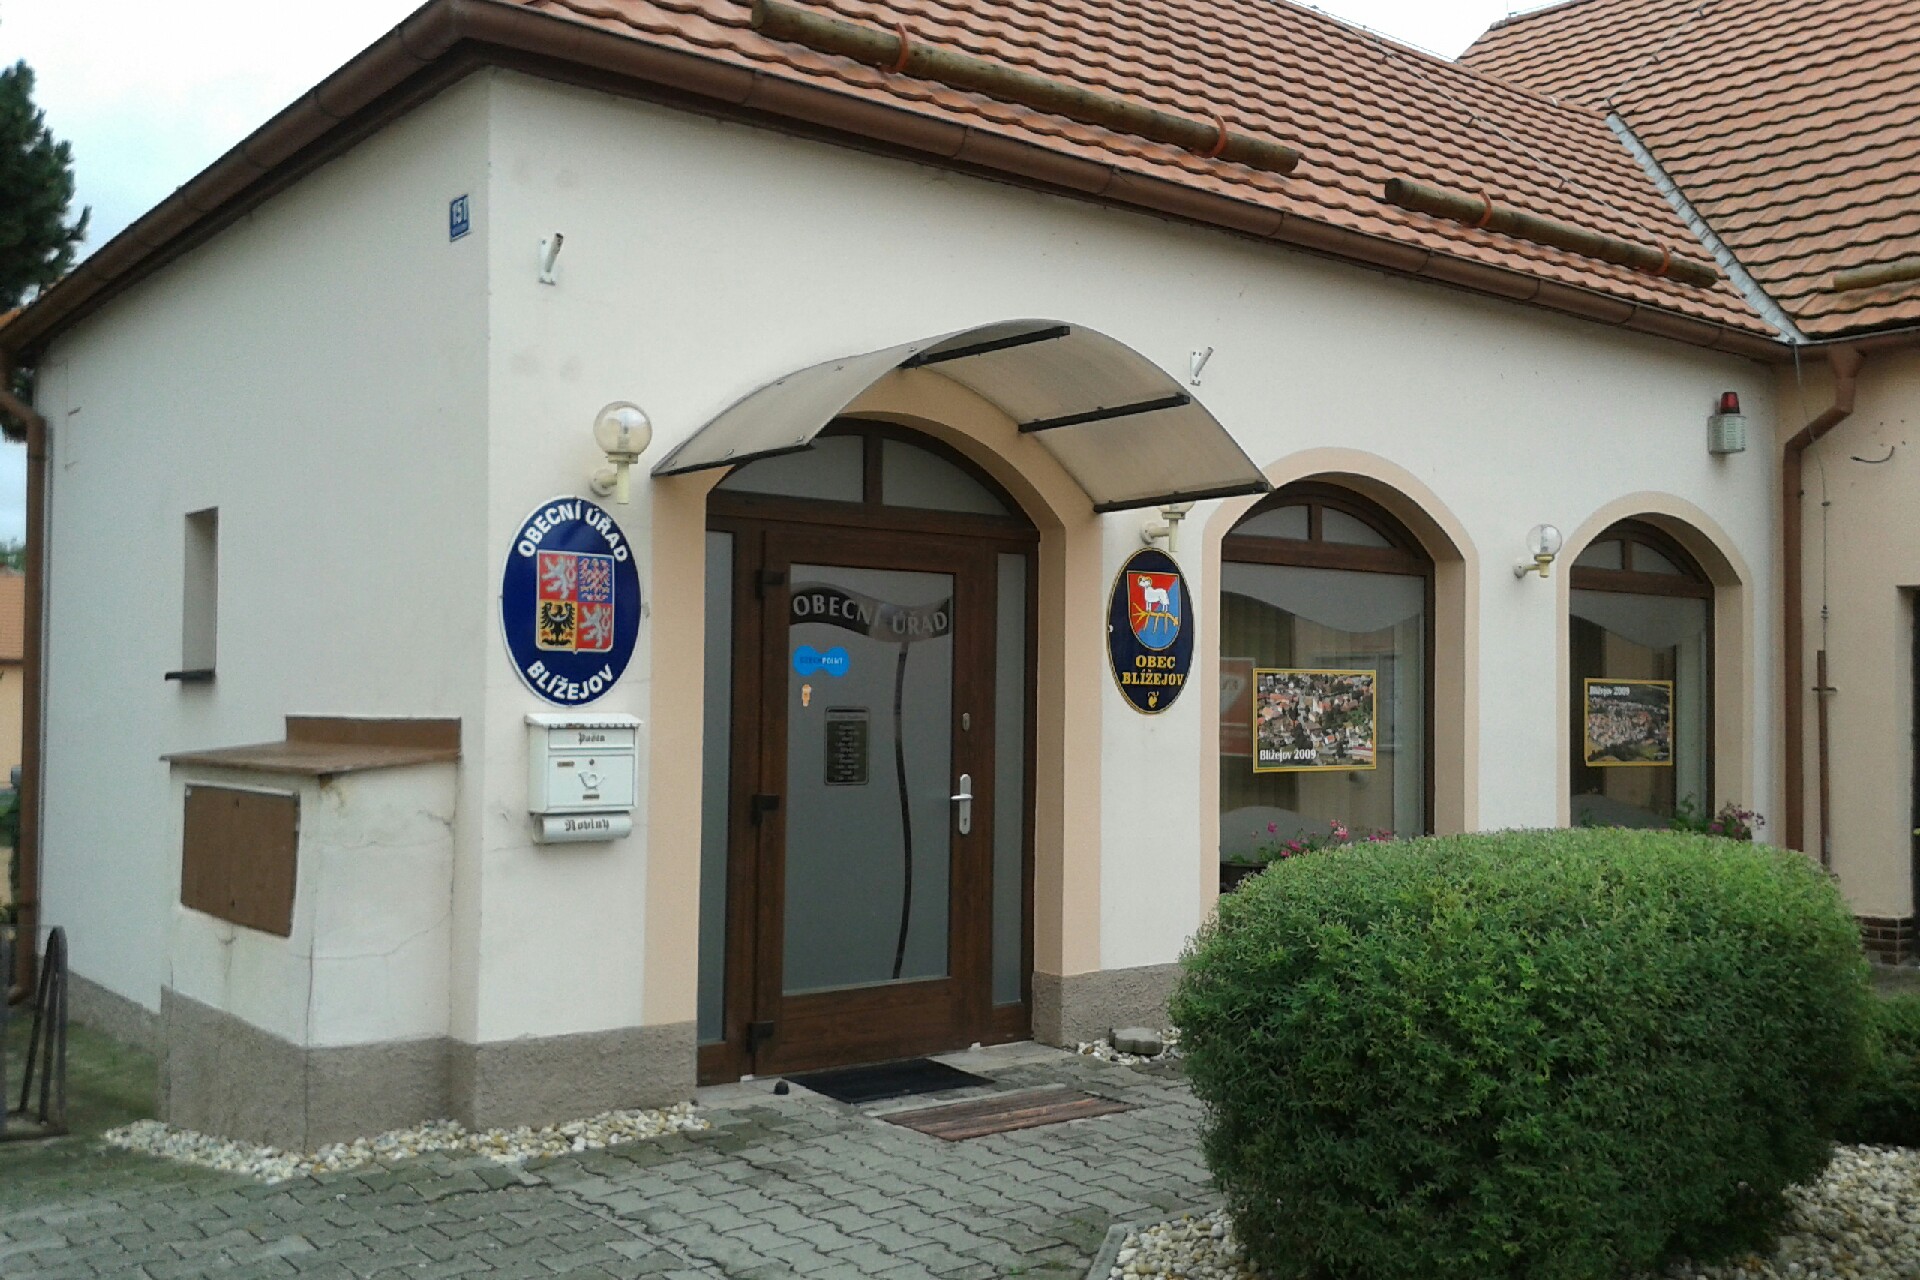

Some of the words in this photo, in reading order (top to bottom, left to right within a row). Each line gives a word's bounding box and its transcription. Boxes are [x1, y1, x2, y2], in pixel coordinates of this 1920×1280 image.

[452, 198, 469, 225] 151
[518, 500, 582, 558] OBECNÍ
[584, 507, 629, 562] ÚŘAD
[793, 594, 883, 627] OBECNÍ
[892, 609, 948, 635] ÚŘAD
[1135, 654, 1176, 669] OBEC
[527, 660, 614, 701] BLÍŽEJOV
[1121, 669, 1185, 686] BLÍŽEJOV
[1293, 749, 1317, 760] 2009
